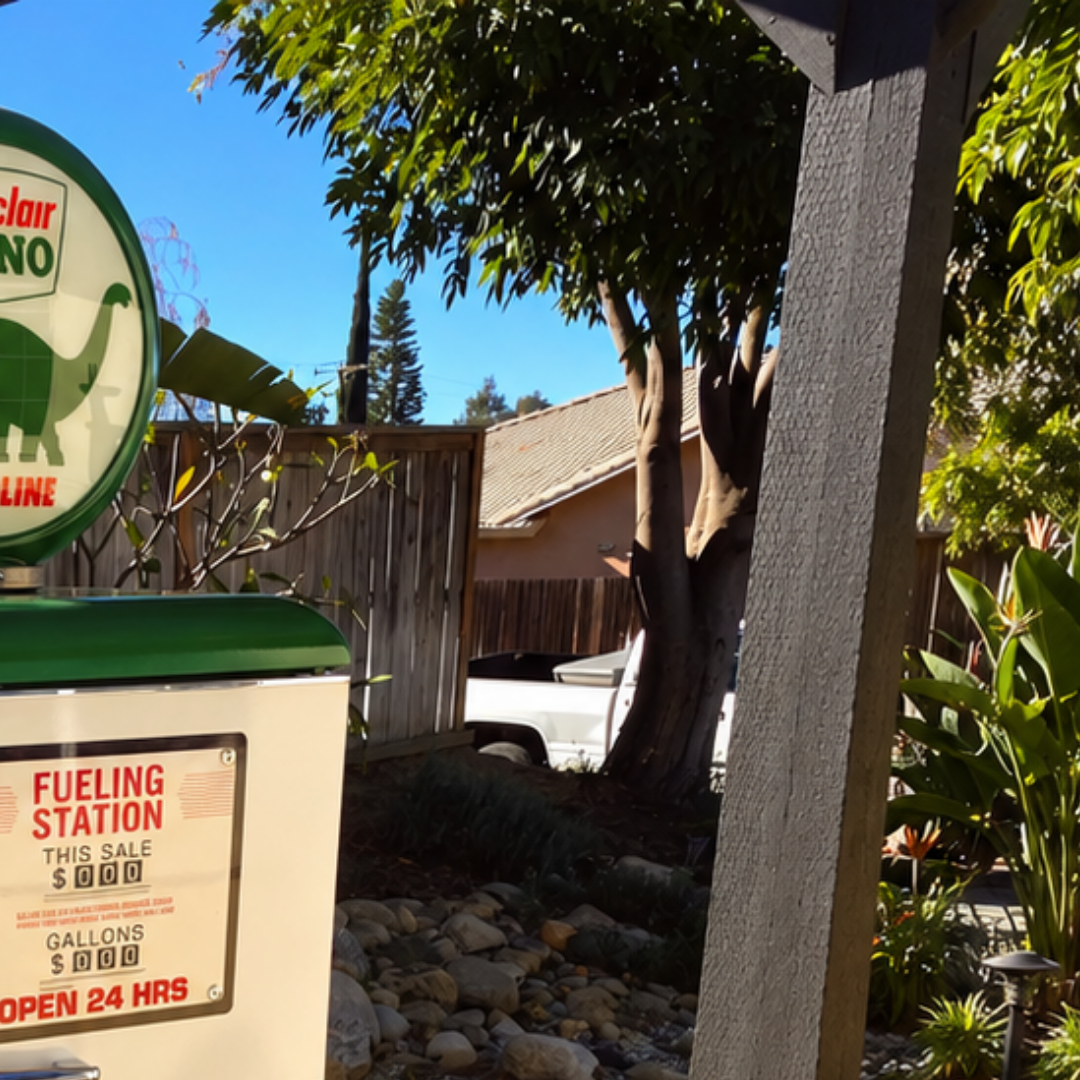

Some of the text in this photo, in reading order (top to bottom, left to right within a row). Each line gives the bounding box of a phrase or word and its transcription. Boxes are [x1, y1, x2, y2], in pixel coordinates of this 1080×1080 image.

[33, 764, 165, 805] FUELING
[32, 800, 163, 840] STATION
[43, 840, 152, 865] THIS SALE
[46, 924, 145, 951] GALLONS
[86, 985, 124, 1013] 24
[132, 976, 189, 1011] HRS
